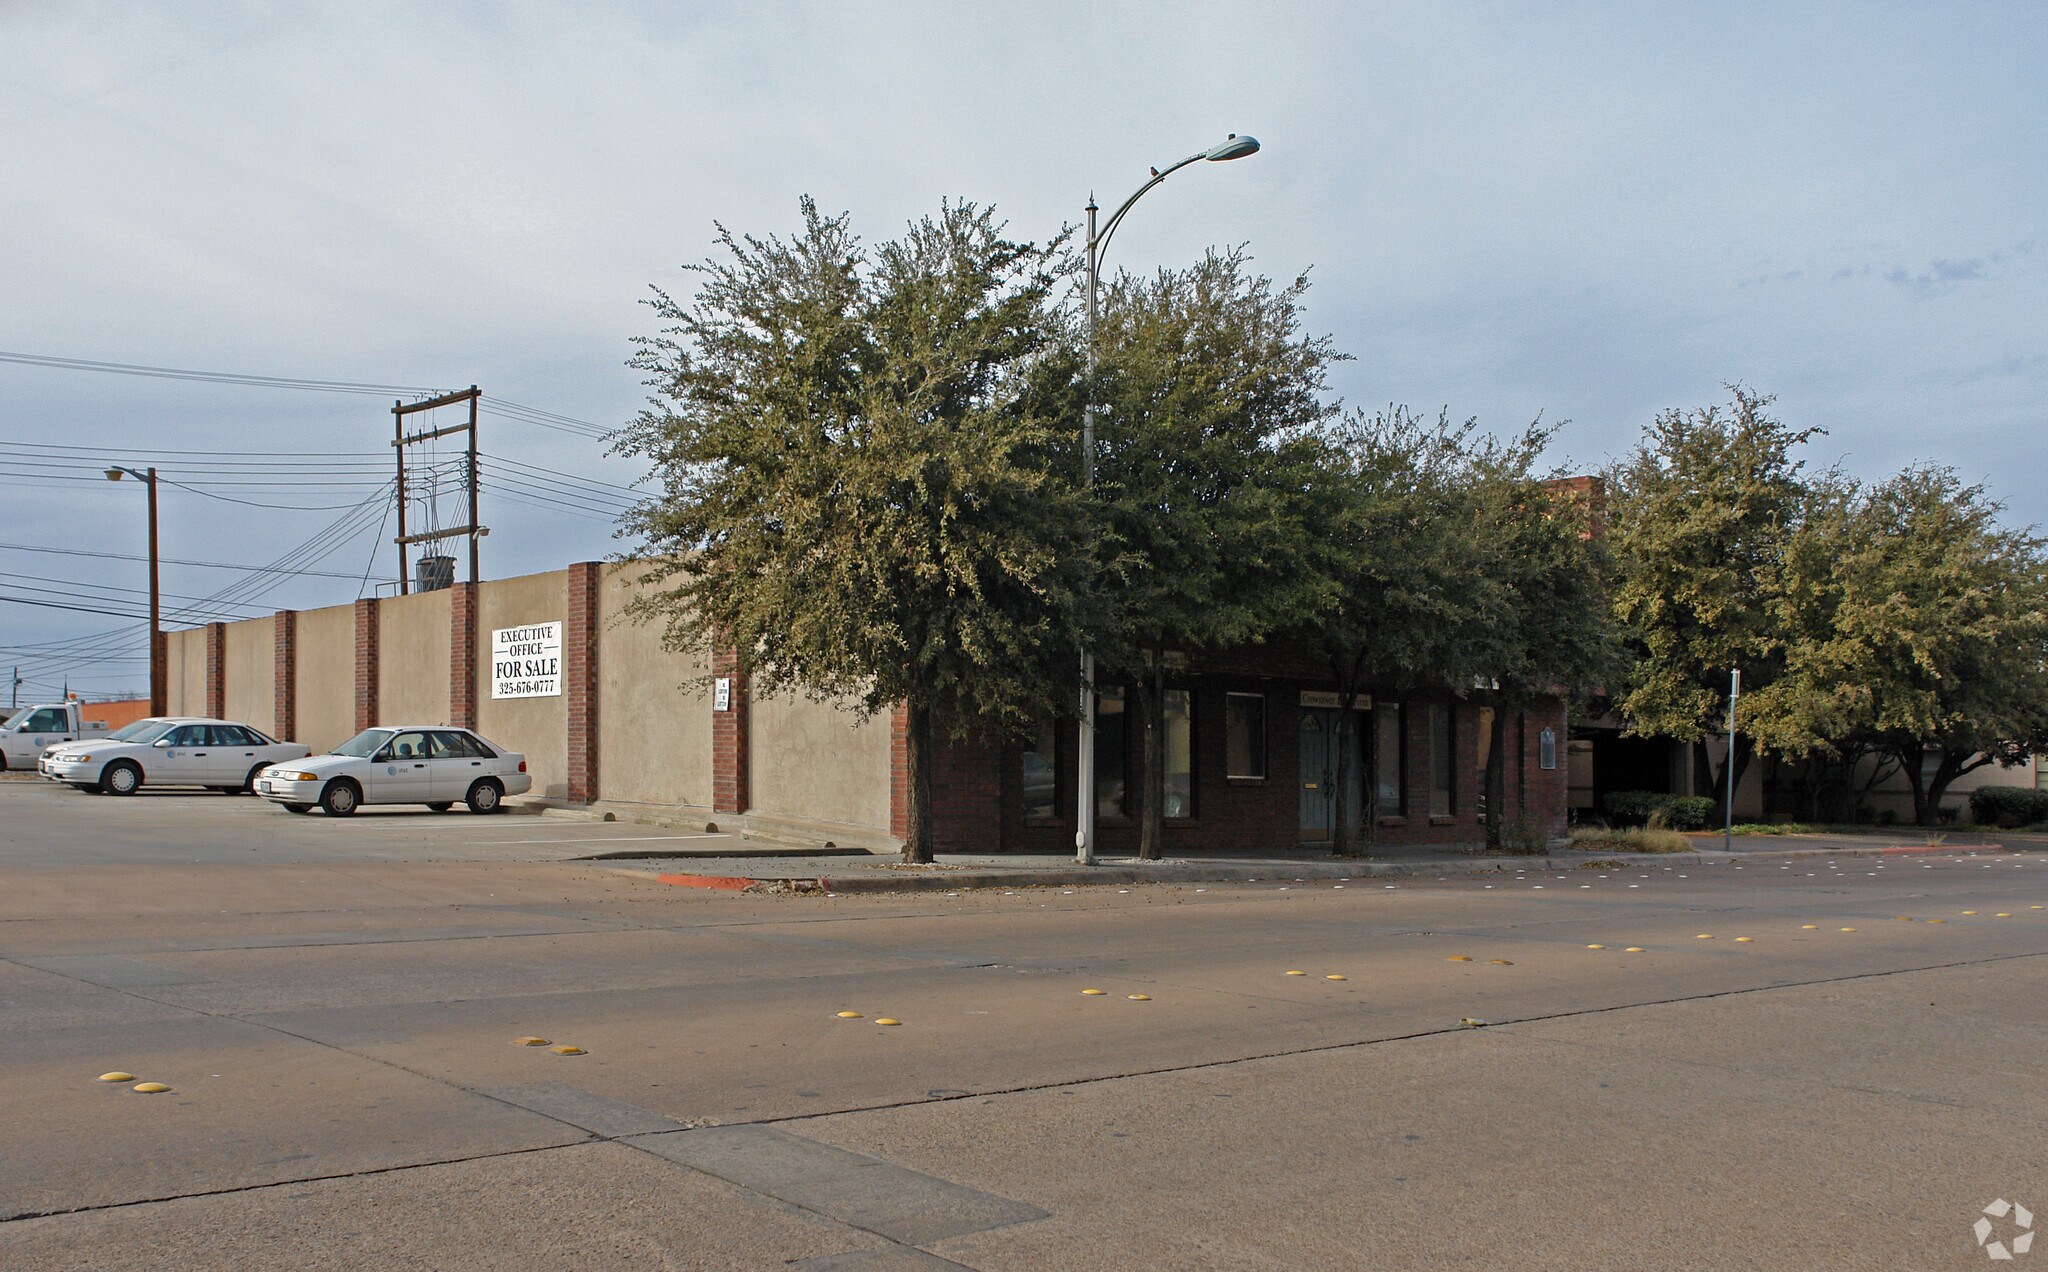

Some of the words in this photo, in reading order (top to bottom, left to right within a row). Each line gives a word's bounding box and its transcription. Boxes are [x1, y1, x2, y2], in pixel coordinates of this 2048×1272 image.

[501, 626, 553, 643] EXECUTIVE
[509, 642, 543, 657] OFFICE
[496, 662, 522, 679] FOR
[525, 658, 558, 677] SALE
[499, 680, 554, 695] 325-676-0777
